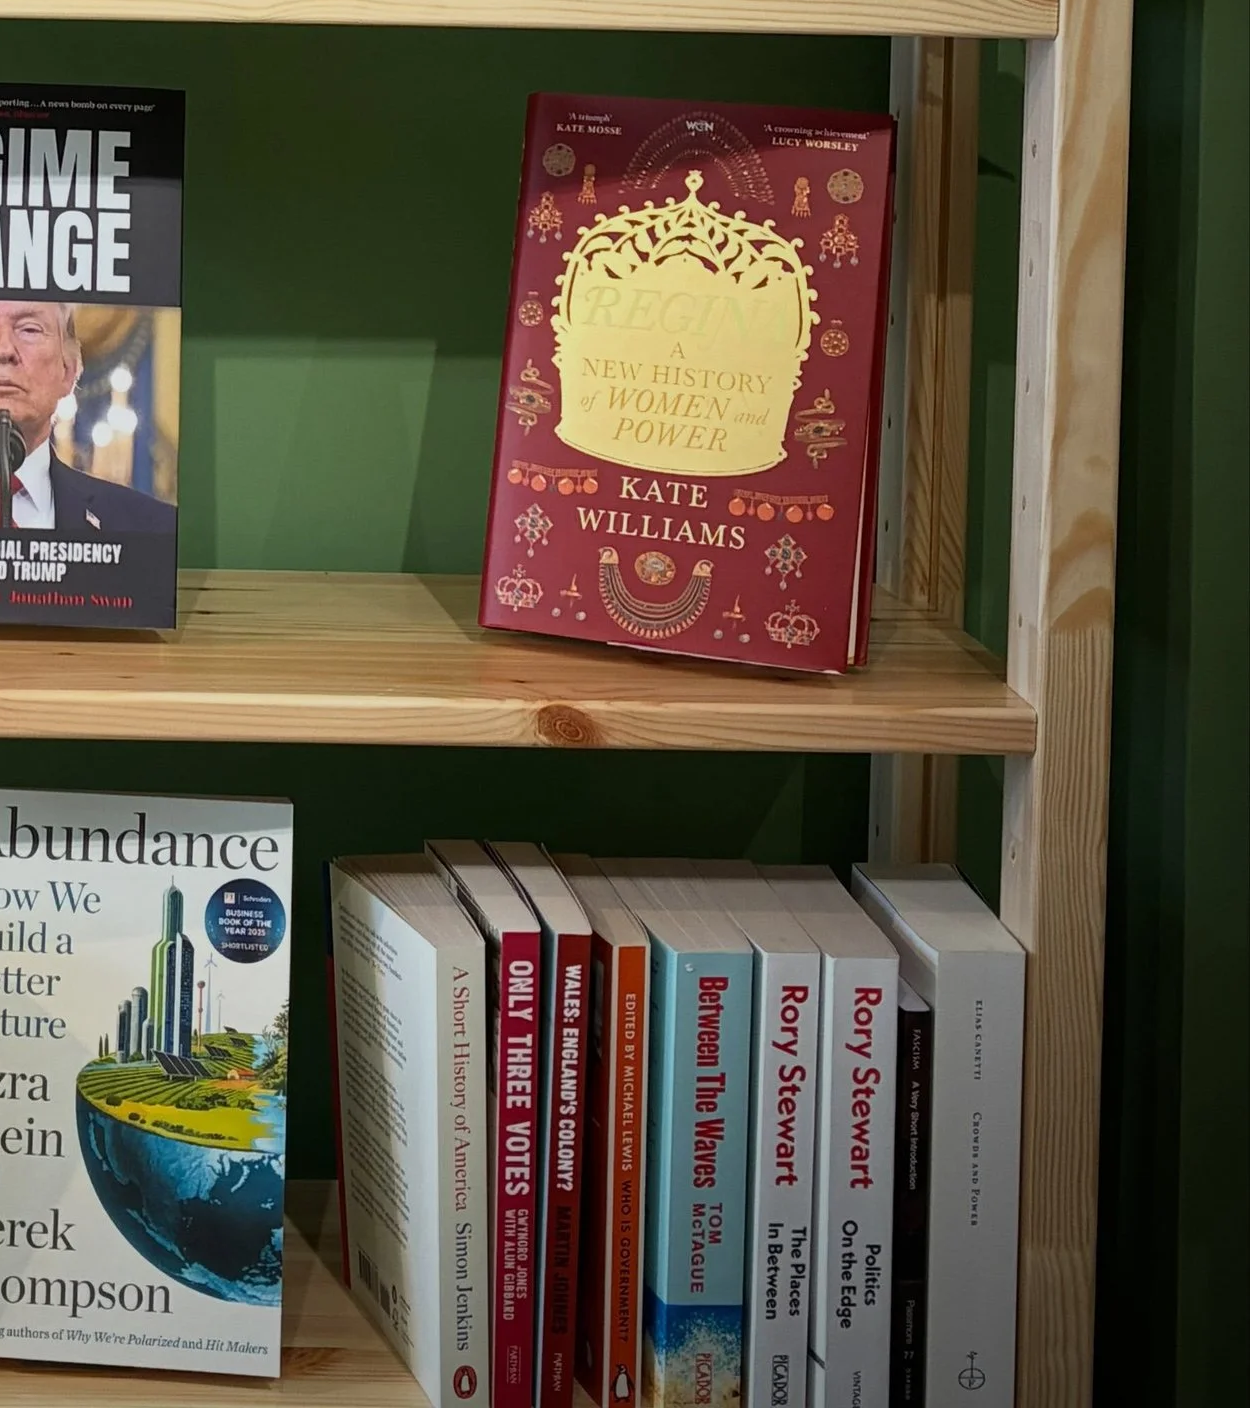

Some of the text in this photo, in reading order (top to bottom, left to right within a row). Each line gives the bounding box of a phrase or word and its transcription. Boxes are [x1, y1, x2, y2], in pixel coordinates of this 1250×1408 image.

[556, 123, 622, 136] KATE MOSSE
[772, 136, 859, 152] LUCY WORSLEY
[582, 358, 773, 395] NEW HISTORY
[580, 386, 771, 427] of WOMEN and
[612, 417, 728, 453] POWER
[619, 475, 708, 509] KATE
[576, 506, 746, 550] WILLIAMS
[29, 541, 122, 564] PRESIDENCY
[12, 561, 66, 583] TRUMP
[48, 880, 102, 914] We
[225, 909, 264, 918] BUSINESS
[218, 918, 272, 929] BOOK OF THE
[224, 927, 266, 937] YEAR 2025
[56, 932, 74, 955] a
[221, 941, 269, 952] SHORTLISTED
[973, 999, 982, 1080] ELIAS CANETTI
[504, 960, 534, 1196] ONLY THREE VOTES
[556, 964, 582, 1192] WALES: ENGLAND'S COLONY?
[692, 976, 729, 1189] Between The Waves
[771, 985, 809, 1186] Rory Stewart
[449, 966, 473, 1351] A Short History of America Simon Jenkins
[6, 1326, 50, 1340] authors
[51, 1328, 64, 1341] of
[66, 1329, 92, 1345] Why
[94, 1331, 126, 1345] We're
[127, 1333, 181, 1349] Polarized
[181, 1337, 202, 1350] and
[205, 1339, 224, 1352] Hit
[226, 1340, 268, 1356] Makers
